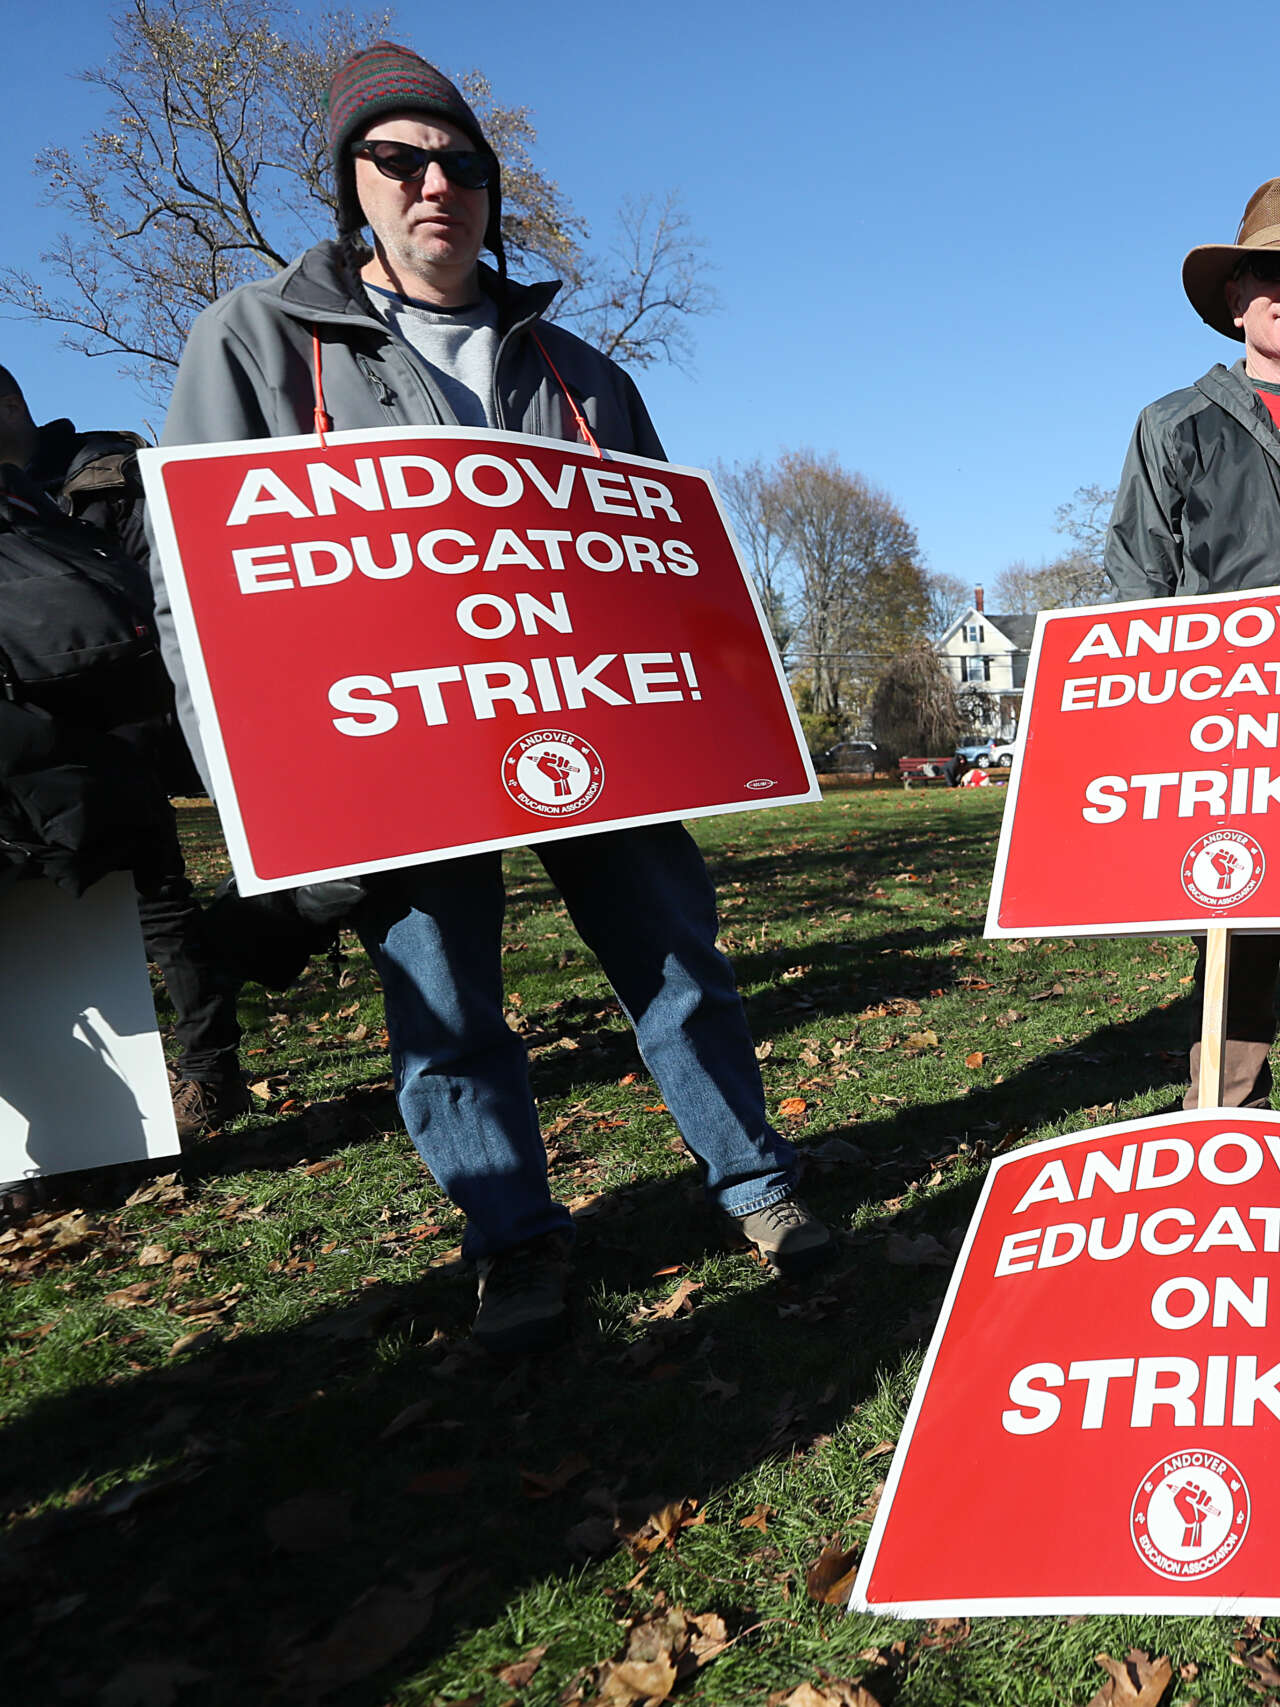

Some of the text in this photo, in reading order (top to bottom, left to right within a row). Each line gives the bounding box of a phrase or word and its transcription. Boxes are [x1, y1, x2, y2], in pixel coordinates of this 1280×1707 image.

[226, 453, 682, 525] ANDOVER
[231, 527, 699, 595] EDUCATORS
[456, 592, 573, 640] ON
[328, 653, 702, 737] STRIKE!
[519, 732, 575, 751] ANDOVER
[1190, 713, 1279, 753] ON
[517, 781, 599, 814] EDUCATION ASSOCIATION
[1203, 832, 1249, 847] ANDOVER
[1151, 1277, 1268, 1329] ON
[1163, 1453, 1227, 1476] ANDOVER
[1139, 1533, 1238, 1575] EDUCATION ASSOCIATION
